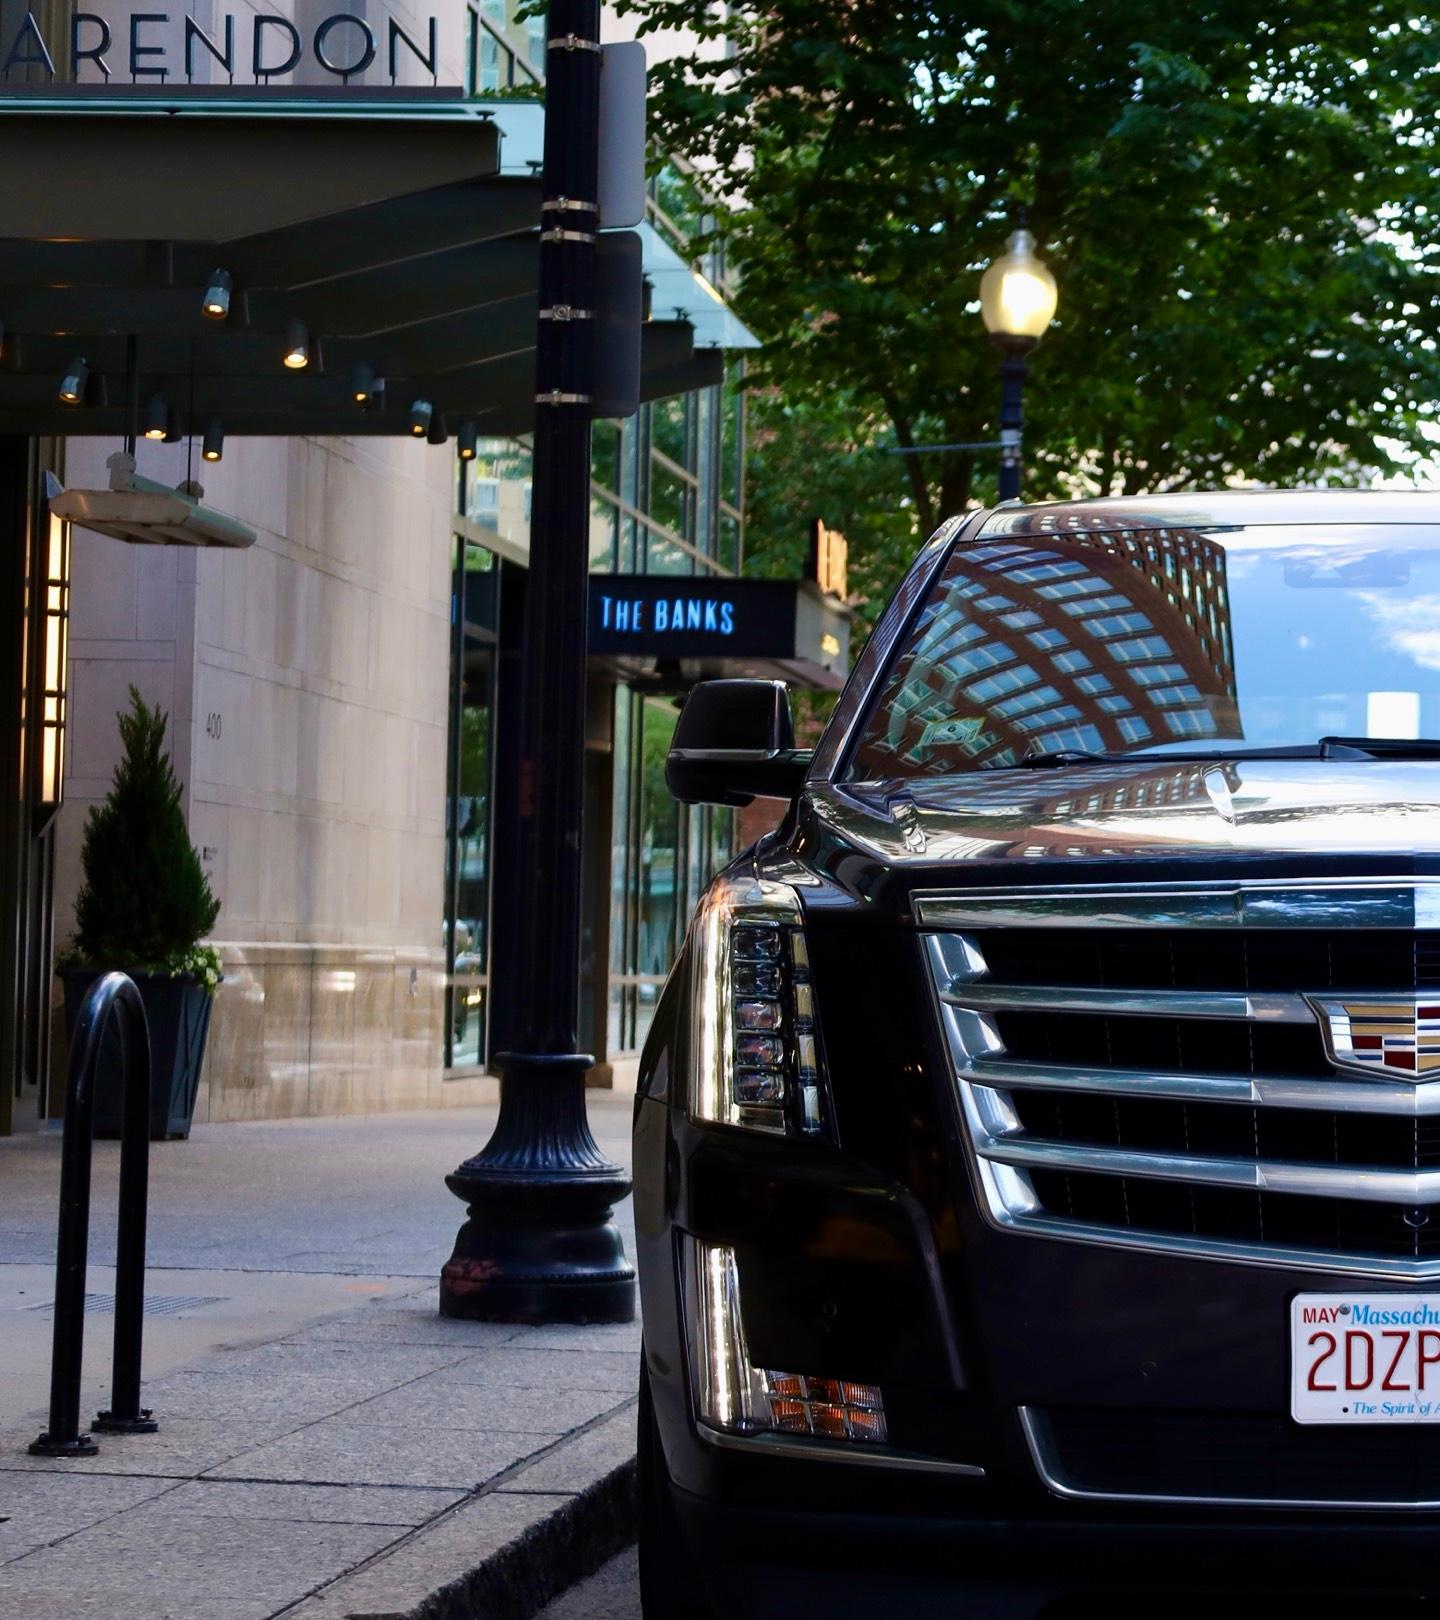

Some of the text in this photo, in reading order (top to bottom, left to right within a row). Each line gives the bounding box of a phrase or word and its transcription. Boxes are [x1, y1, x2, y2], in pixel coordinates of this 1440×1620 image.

[2, 12, 438, 76] ARENDON
[602, 596, 734, 635] THE BANKS
[206, 712, 222, 740] 400
[1303, 1307, 1340, 1323] MAY
[1353, 1402, 1377, 1415] The
[1381, 1401, 1415, 1416] Spirit
[1419, 1402, 1432, 1416] of
